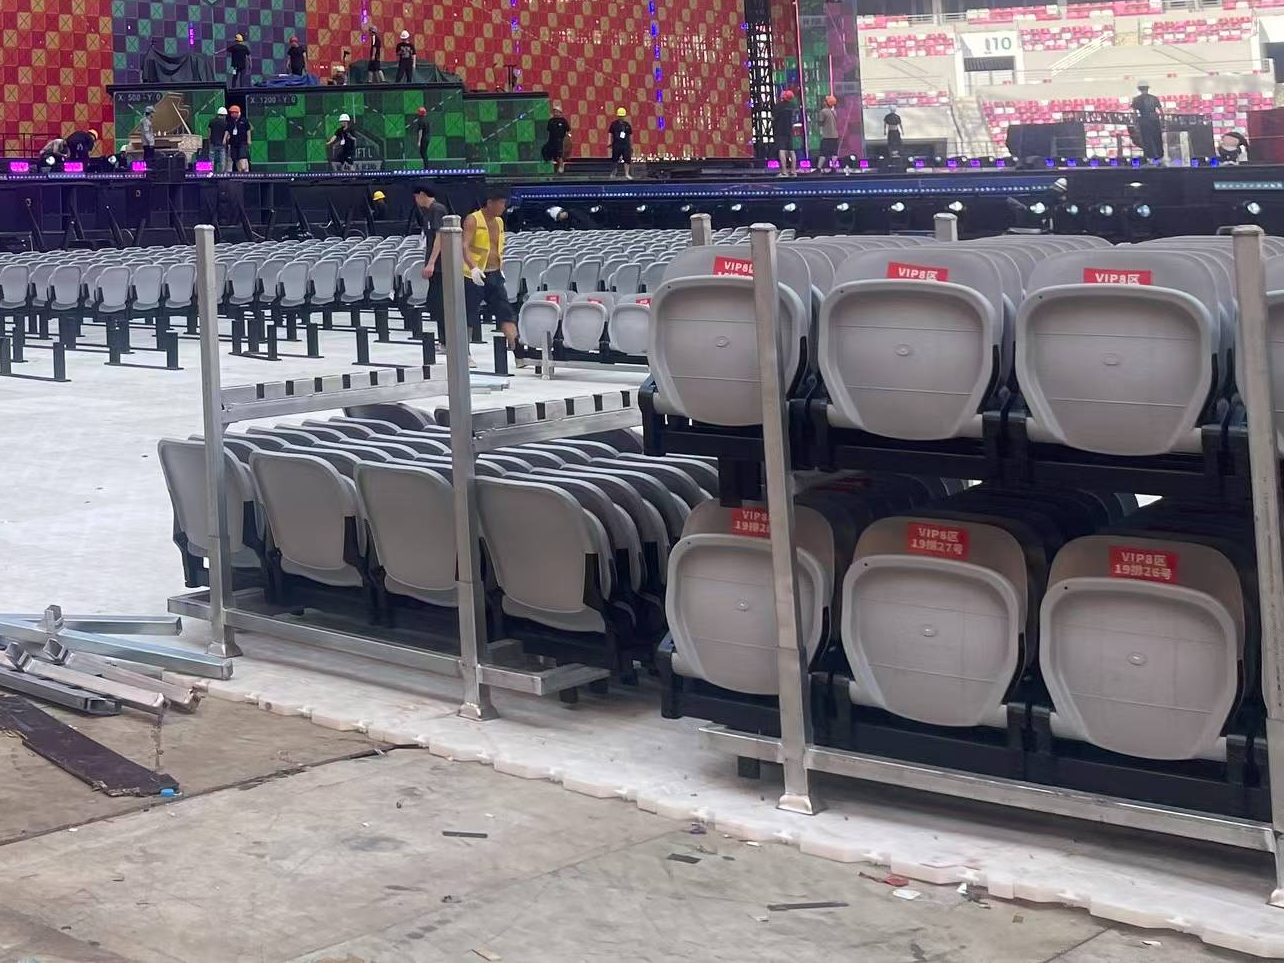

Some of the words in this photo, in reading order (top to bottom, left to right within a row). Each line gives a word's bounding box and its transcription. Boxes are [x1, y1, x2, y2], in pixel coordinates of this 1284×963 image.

[898, 266, 938, 282] VIP8区
[1094, 272, 1141, 285] VIP8区
[918, 527, 960, 543] VIP8区
[1120, 551, 1167, 567] VIP8区
